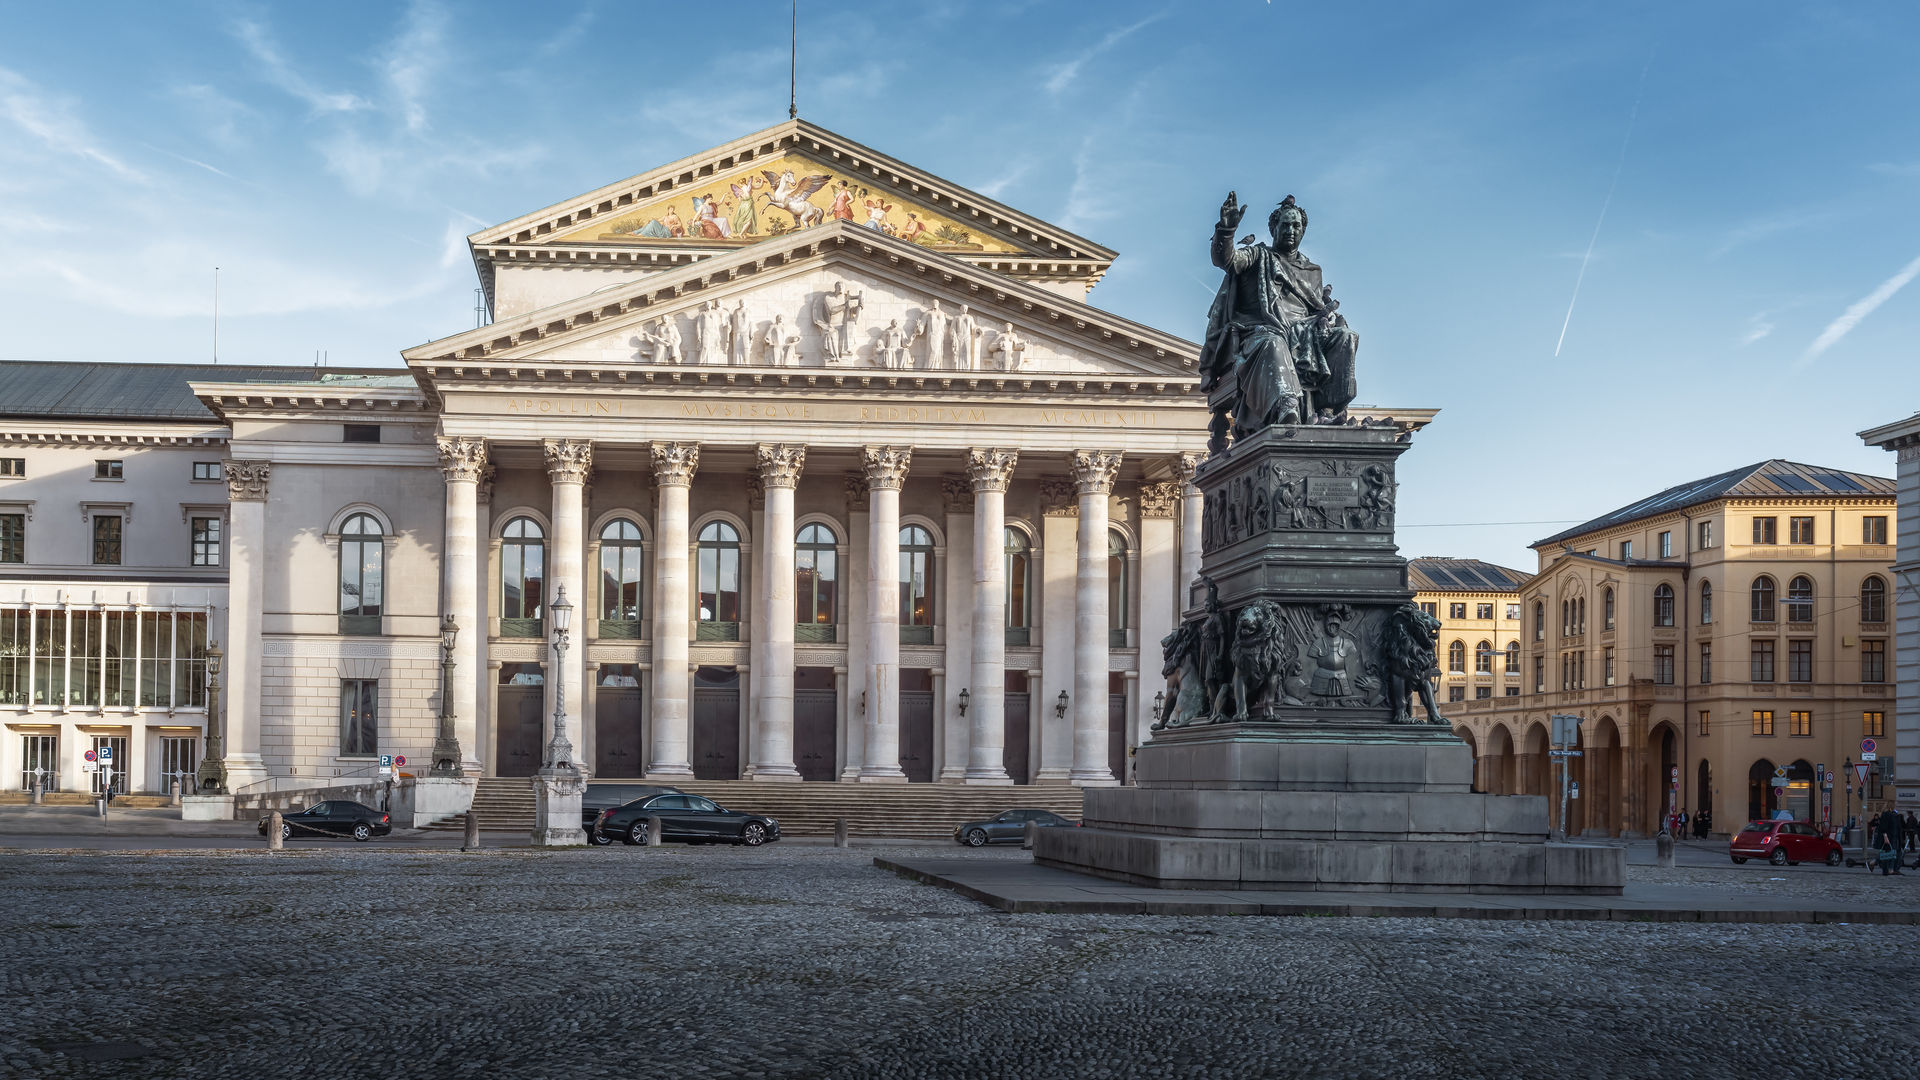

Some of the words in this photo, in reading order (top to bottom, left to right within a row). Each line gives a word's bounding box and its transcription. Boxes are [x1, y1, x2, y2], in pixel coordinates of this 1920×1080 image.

[507, 399, 622, 416] APOLLINI
[680, 402, 811, 418] MVSISQVE
[859, 406, 987, 423] REDDITVM
[1039, 409, 1156, 425] MCMLXIII
[101, 748, 108, 758] P
[382, 756, 388, 765] P
